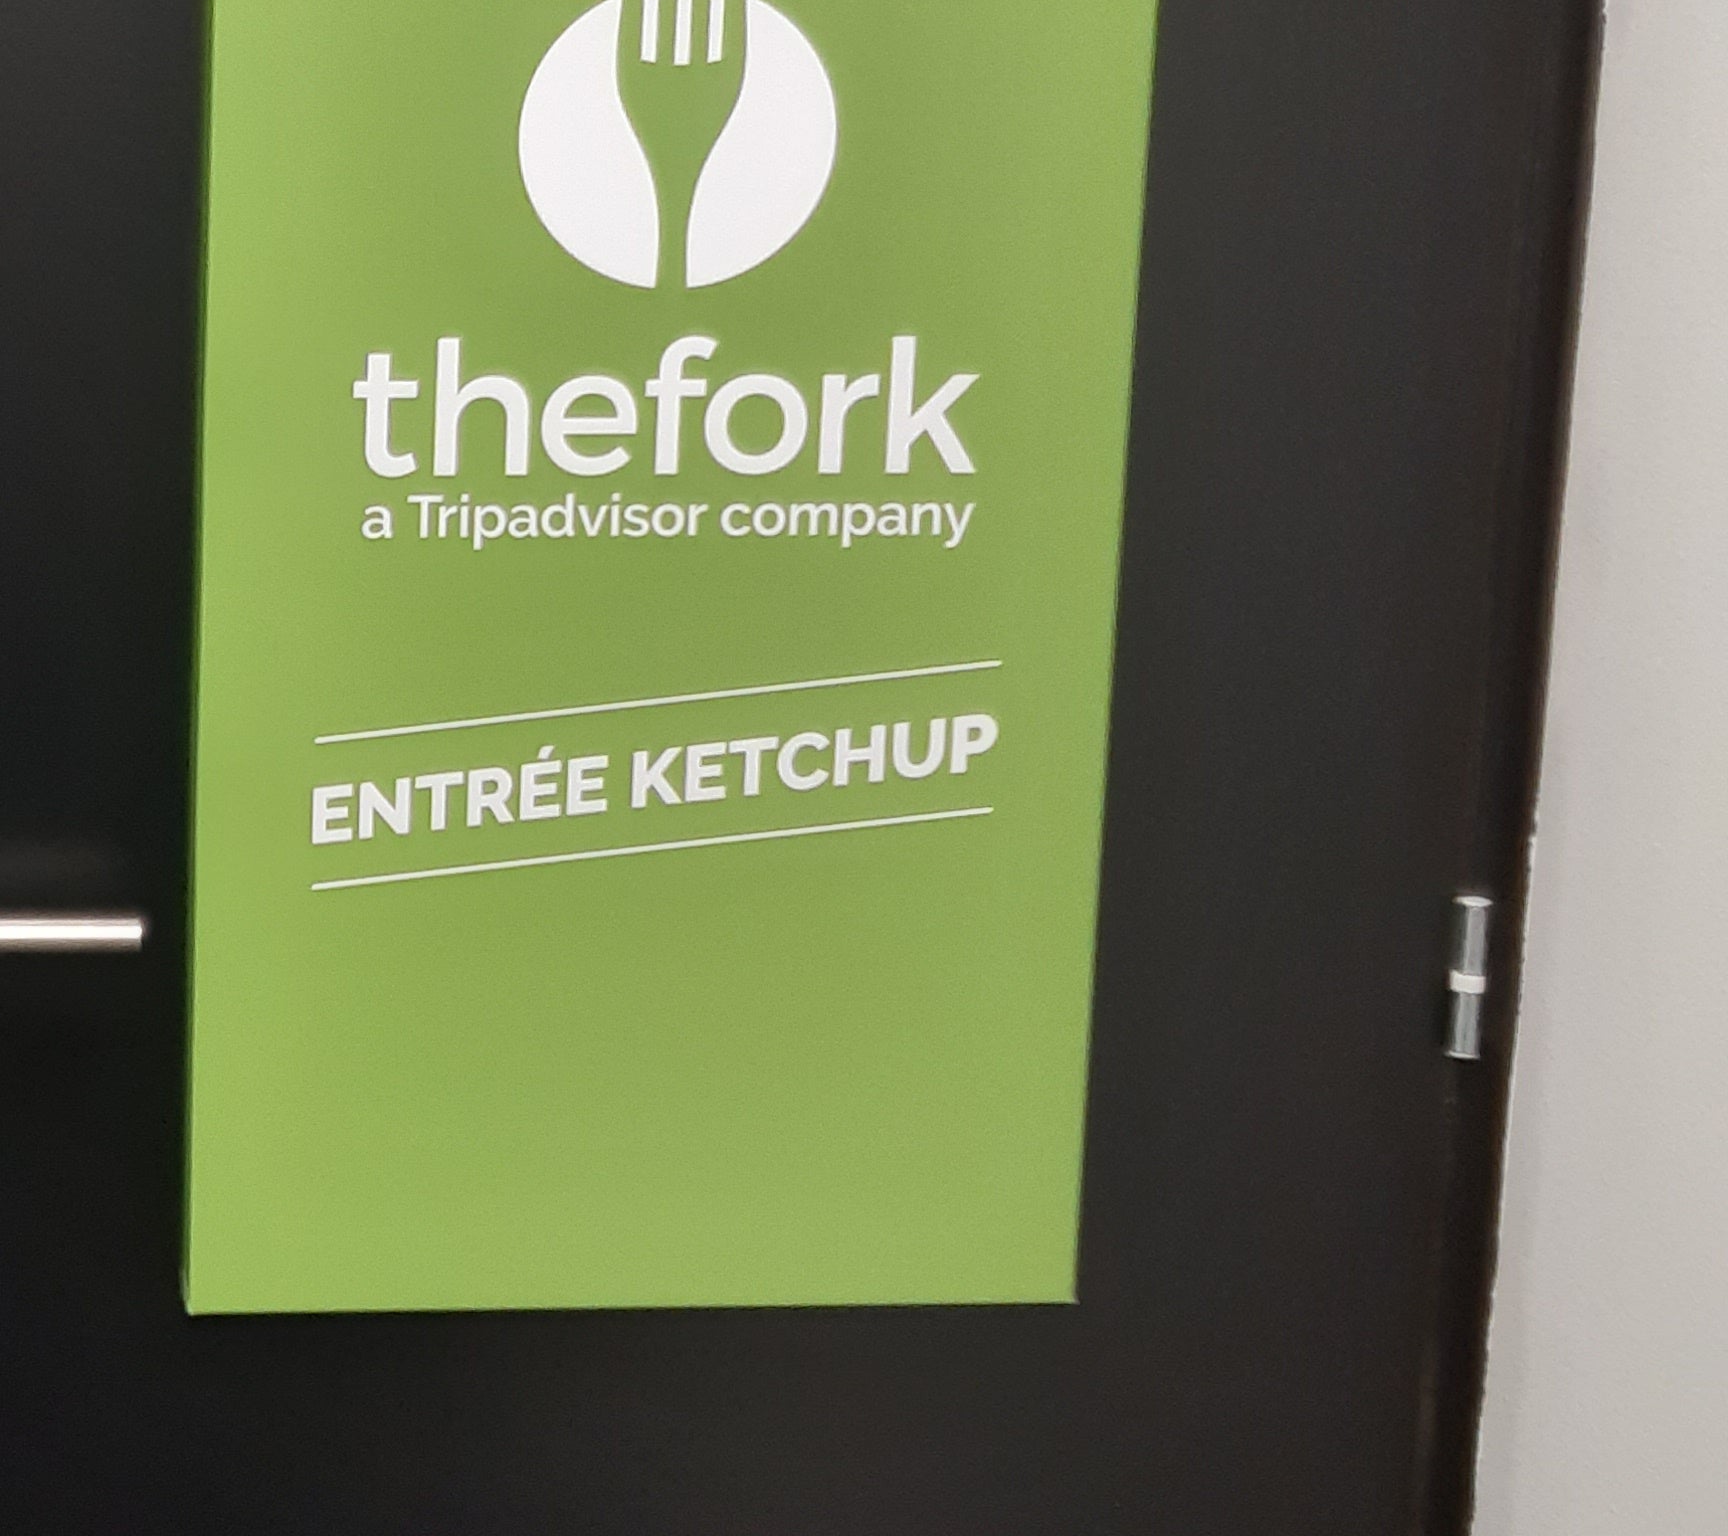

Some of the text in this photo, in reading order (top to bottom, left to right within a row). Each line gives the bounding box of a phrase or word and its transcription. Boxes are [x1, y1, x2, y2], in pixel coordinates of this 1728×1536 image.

[352, 334, 980, 478] thefork
[361, 492, 975, 550] a Tripadvisor company
[311, 713, 999, 845] ENTRÉE KETCHUP
